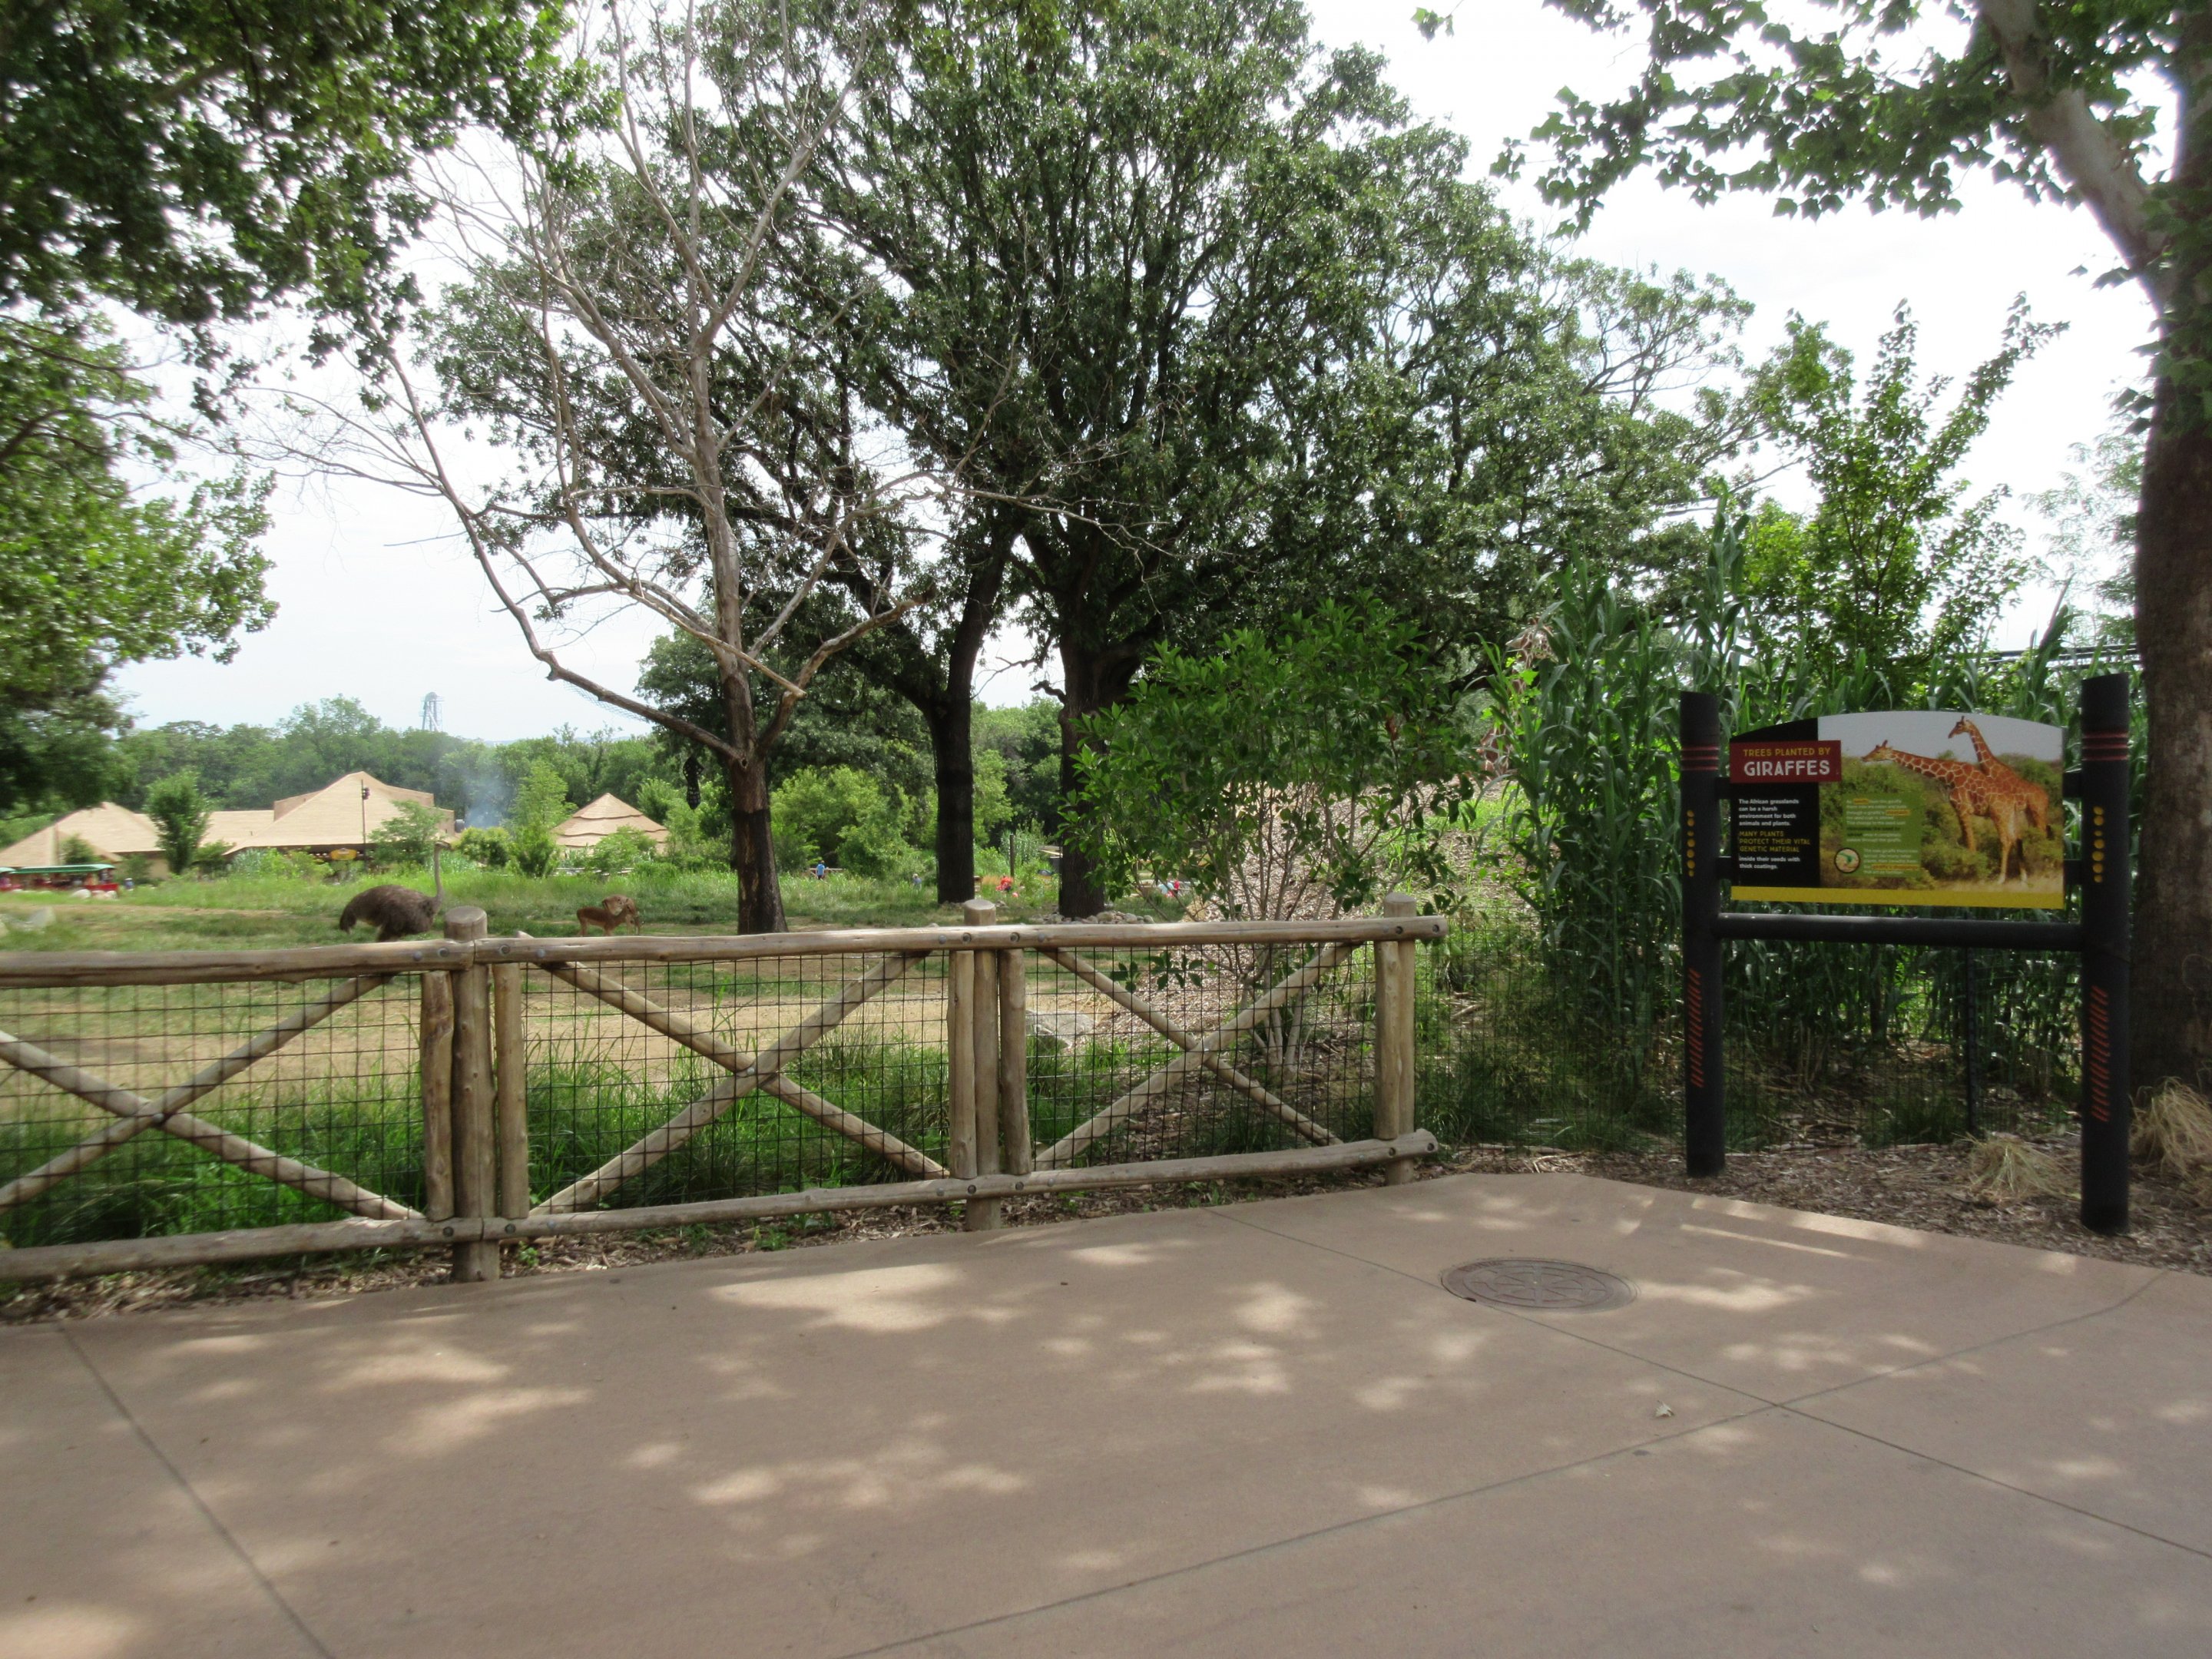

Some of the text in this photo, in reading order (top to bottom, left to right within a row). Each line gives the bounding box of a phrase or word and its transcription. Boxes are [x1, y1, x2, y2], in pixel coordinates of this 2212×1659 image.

[1775, 747, 1816, 757] PLANTED
[1818, 747, 1831, 756] BY
[1743, 759, 1830, 777] GIRAFFES
